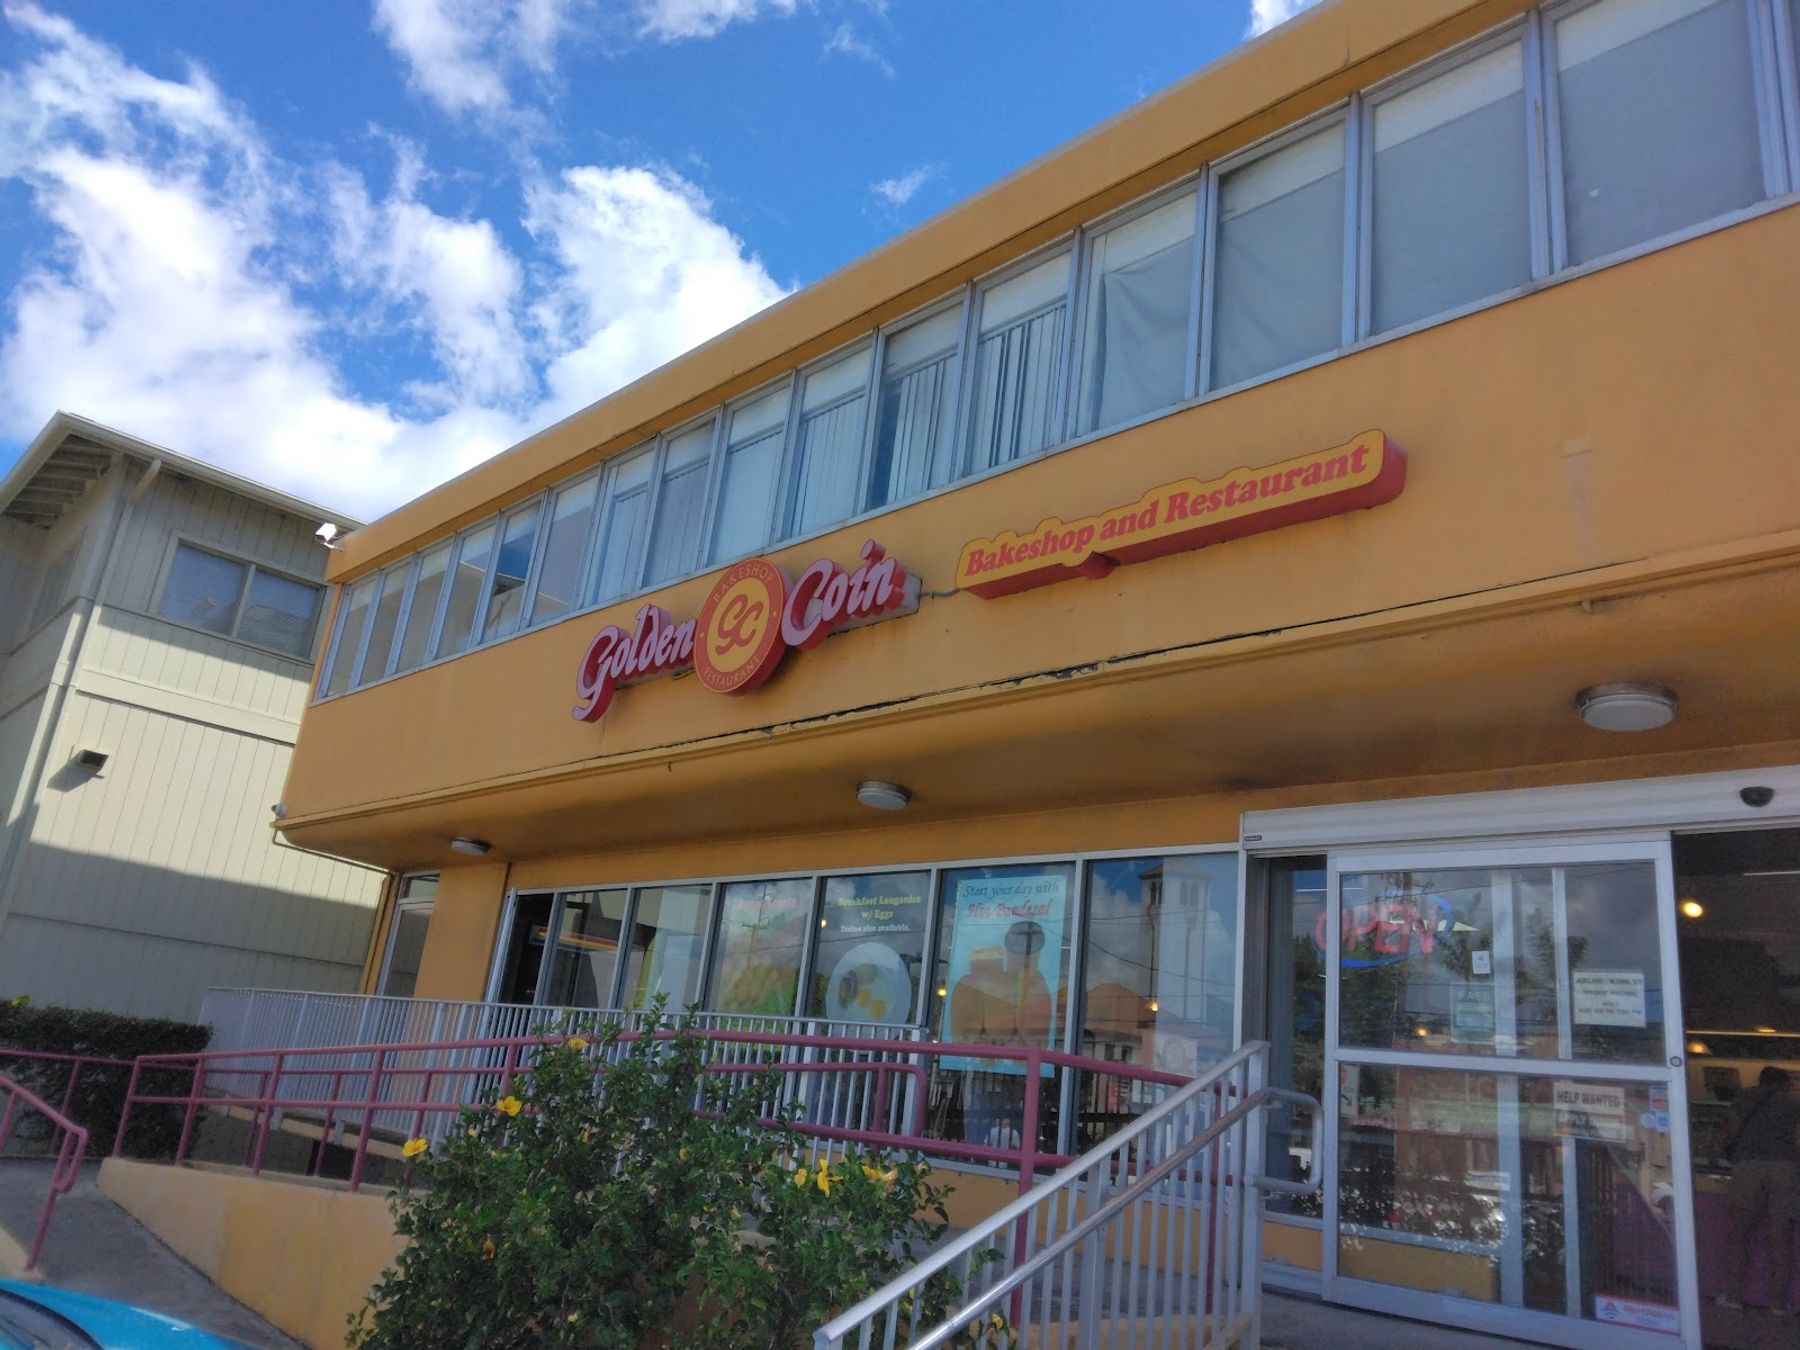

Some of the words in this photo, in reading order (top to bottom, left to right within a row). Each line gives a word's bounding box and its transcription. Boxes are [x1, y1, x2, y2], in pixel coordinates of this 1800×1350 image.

[964, 522, 1095, 577] Bakeshop
[1099, 500, 1158, 541] and
[1163, 443, 1370, 524] Restaurant
[572, 603, 697, 721] Golden
[780, 539, 900, 648] Coin
[963, 885, 988, 897] Start
[988, 886, 1013, 900] your
[1014, 881, 1033, 897] day
[1035, 882, 1059, 894] with
[1314, 903, 1438, 954] OPEN
[1556, 1089, 1580, 1104] HELP
[1581, 1092, 1620, 1108] WANTED
